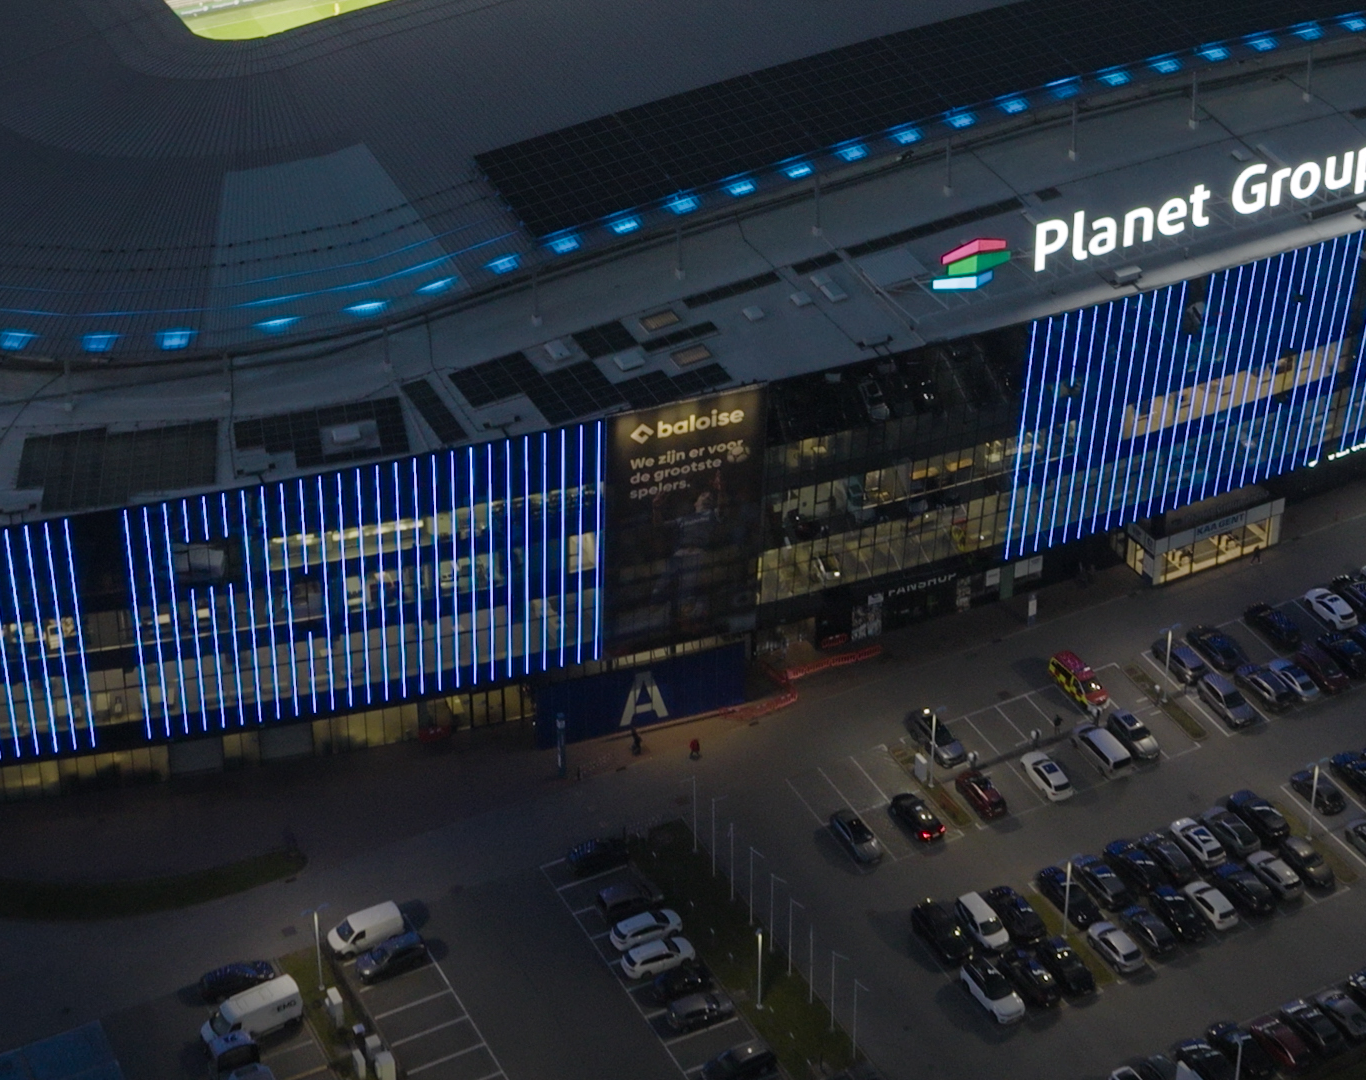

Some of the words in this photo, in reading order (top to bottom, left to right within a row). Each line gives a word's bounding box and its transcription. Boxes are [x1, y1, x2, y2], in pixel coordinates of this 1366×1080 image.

[1034, 183, 1210, 272] Planet
[657, 409, 745, 439] baloise
[630, 457, 655, 471] We
[658, 449, 686, 465] zijn
[689, 445, 706, 459] er
[707, 439, 744, 455] voor
[630, 471, 651, 485] de
[654, 458, 722, 482] grootste
[629, 478, 691, 500] spelers.
[1196, 521, 1217, 536] KAA
[1219, 513, 1245, 529] GENT
[621, 671, 669, 726] A
